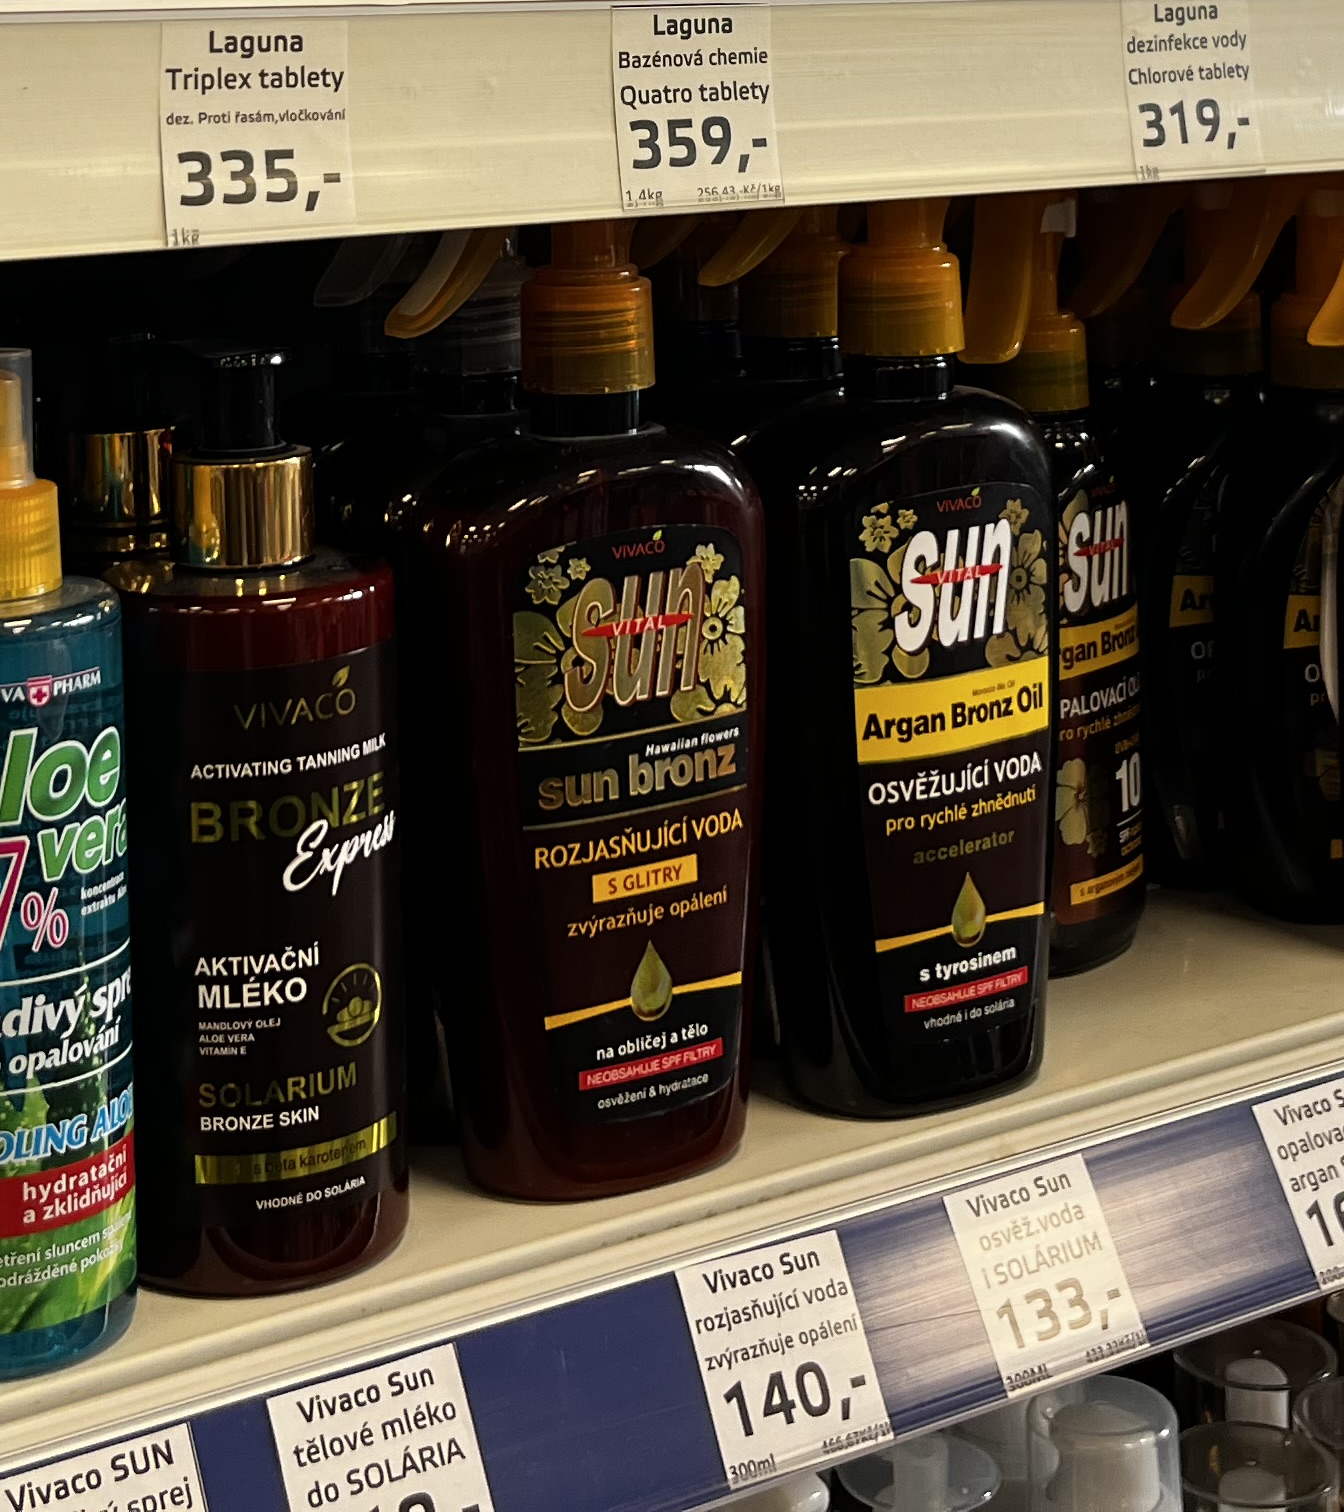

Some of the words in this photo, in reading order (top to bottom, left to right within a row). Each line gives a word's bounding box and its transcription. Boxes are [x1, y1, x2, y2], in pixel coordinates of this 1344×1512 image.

[653, 14, 733, 40] Laguna
[1153, 3, 1219, 26] Laguna
[209, 30, 304, 59] Laguna
[1126, 32, 1208, 54] dezinfekce
[1211, 29, 1247, 50] vody
[618, 49, 704, 69] Bazénová
[708, 46, 769, 66] chemie
[165, 66, 253, 96] Triplex
[258, 65, 345, 93] tablety
[1128, 64, 1194, 85] Chlorové
[620, 85, 693, 110] Quatro
[698, 80, 770, 105] tablety
[198, 111, 232, 125] Proti
[612, 614, 666, 637] VITAL
[53, 670, 102, 697] PHARM
[233, 687, 356, 731] VIVACO
[862, 711, 947, 743] Argan
[1017, 681, 1044, 713] Oil
[190, 757, 292, 781] ACTIVATING
[296, 743, 361, 771] TANNING
[362, 732, 387, 755] MILK
[1115, 751, 1142, 814] 10
[190, 769, 386, 844] BRONZE
[885, 816, 916, 836] pro
[920, 804, 968, 830] rychlé
[534, 816, 690, 870] ROZJASŇUJÍCÍ
[692, 808, 744, 841] VODA
[623, 863, 684, 892] GLITRY
[194, 940, 320, 977] AKTIVAČNÍ
[934, 946, 1017, 981] tyrosinem
[198, 976, 308, 1010] MLÉKO
[256, 1017, 282, 1029] OLEJ
[923, 1011, 963, 1030] vhodné
[618, 1031, 667, 1057] obličej
[681, 1022, 709, 1040] tělo
[200, 1112, 275, 1132] BRONZE
[279, 1105, 320, 1127] SKIN
[1273, 1098, 1332, 1127] Vivaco
[1033, 1169, 1072, 1195] Sun
[1289, 1165, 1340, 1194] argan
[256, 1191, 304, 1210] VHODNÉ
[44, 1231, 101, 1260] sluncem
[701, 1263, 775, 1295] Vivaco
[778, 1248, 821, 1276] Sun
[693, 1288, 801, 1335] rozjasňující
[802, 1277, 849, 1302] voda
[704, 1331, 796, 1374] zvýrazňuje
[722, 1361, 867, 1438] 140,-
[292, 1423, 375, 1469] tělové
[381, 1399, 458, 1442] mléko
[110, 1439, 176, 1484] SUN
[345, 1437, 467, 1497] SOLÁRIA
